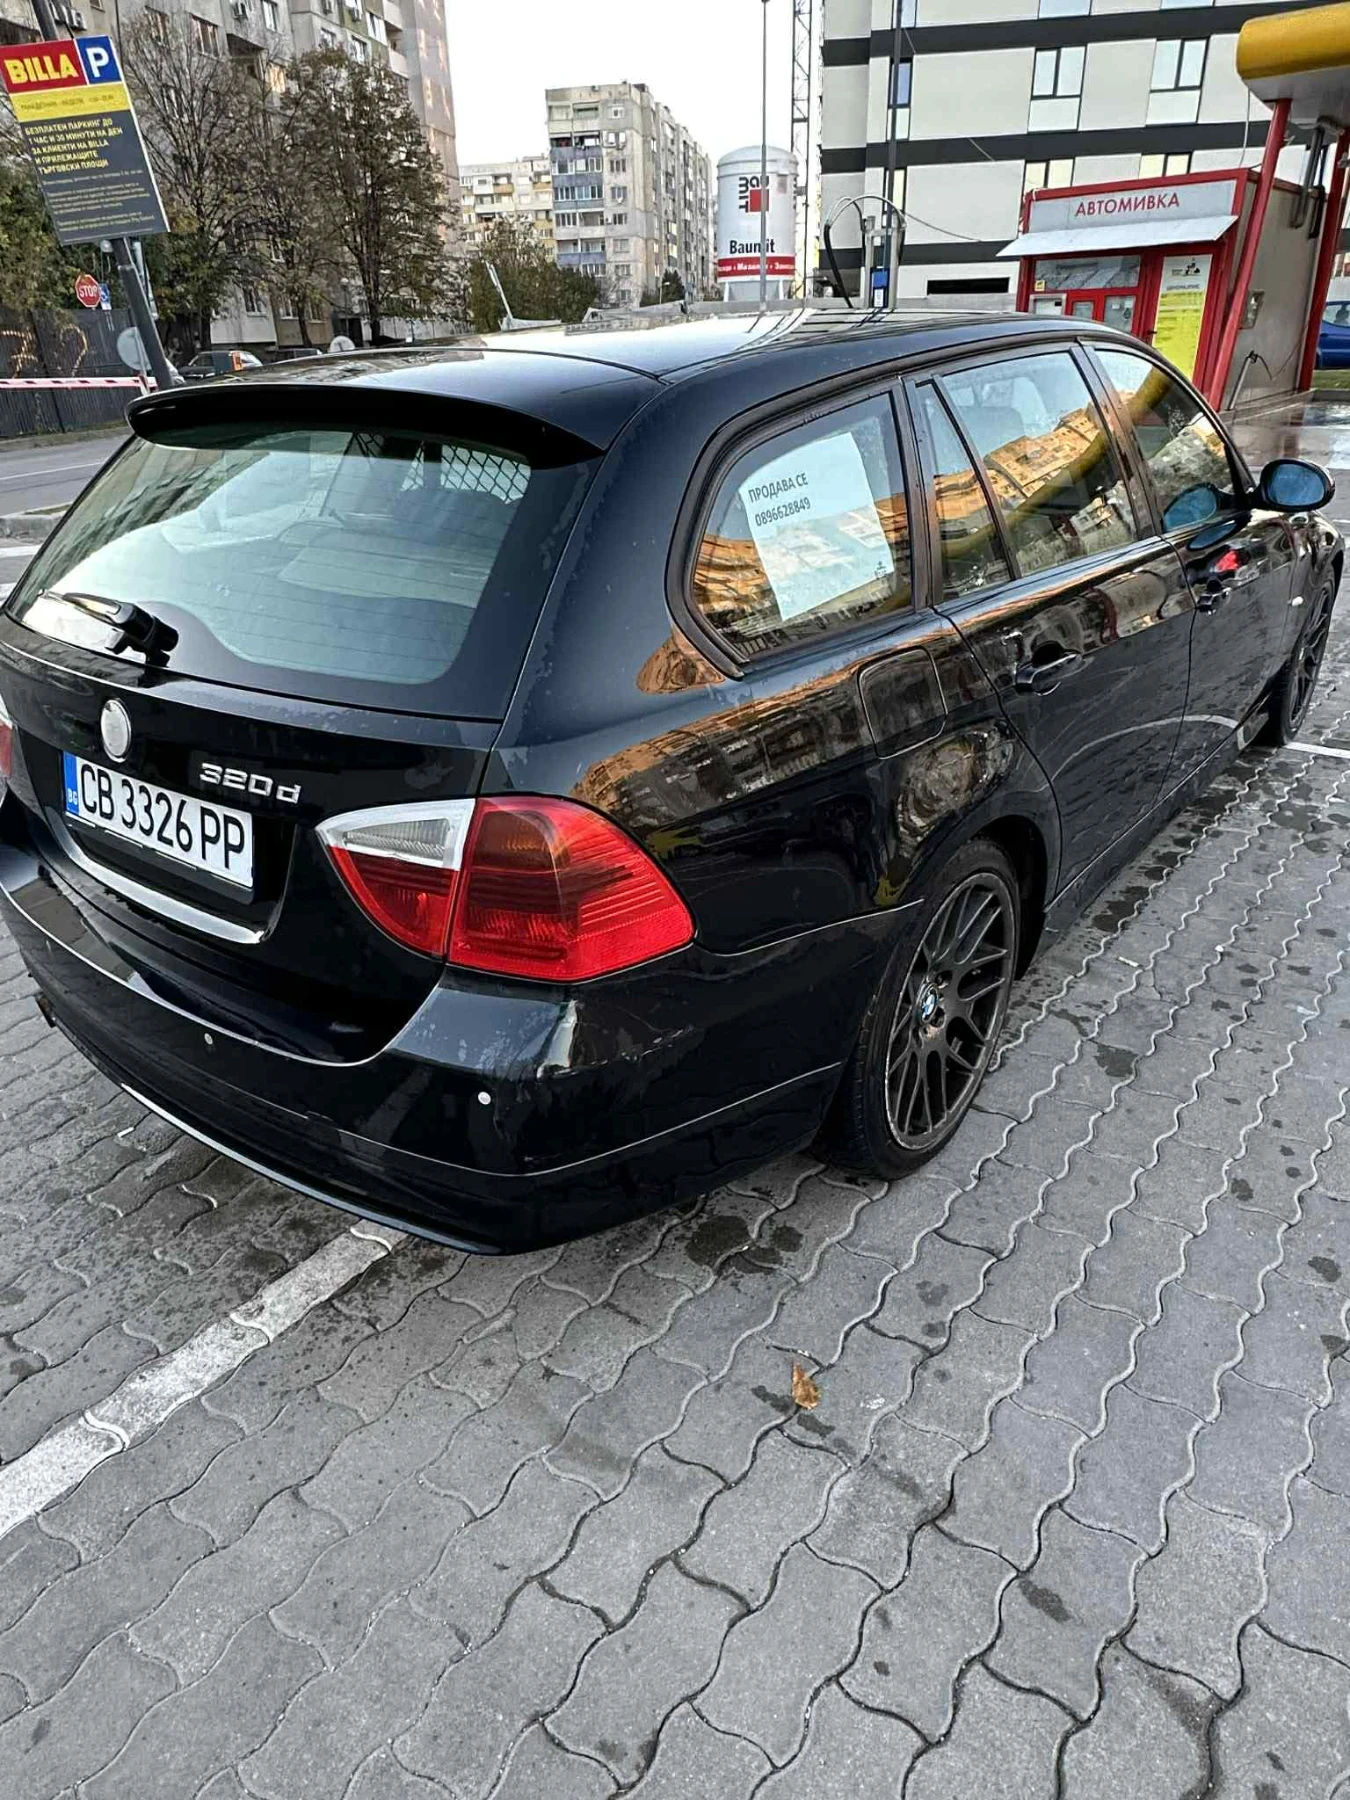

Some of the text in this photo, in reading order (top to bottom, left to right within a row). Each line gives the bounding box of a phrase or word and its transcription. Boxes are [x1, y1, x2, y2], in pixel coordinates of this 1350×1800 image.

[3, 54, 79, 84] BILLA
[85, 47, 109, 78] P
[33, 134, 49, 144] ЧАС
[65, 130, 96, 140] МИНУТИ
[97, 129, 108, 137] НА
[68, 119, 100, 130] ПАРКИНГ
[1075, 192, 1180, 217] АВТОМИВКА
[729, 238, 776, 255] Baumit
[79, 285, 98, 298] STOP
[748, 472, 809, 503] ПРОДАВА СЕ
[755, 497, 811, 527] 0896628849
[200, 762, 302, 804] 320d
